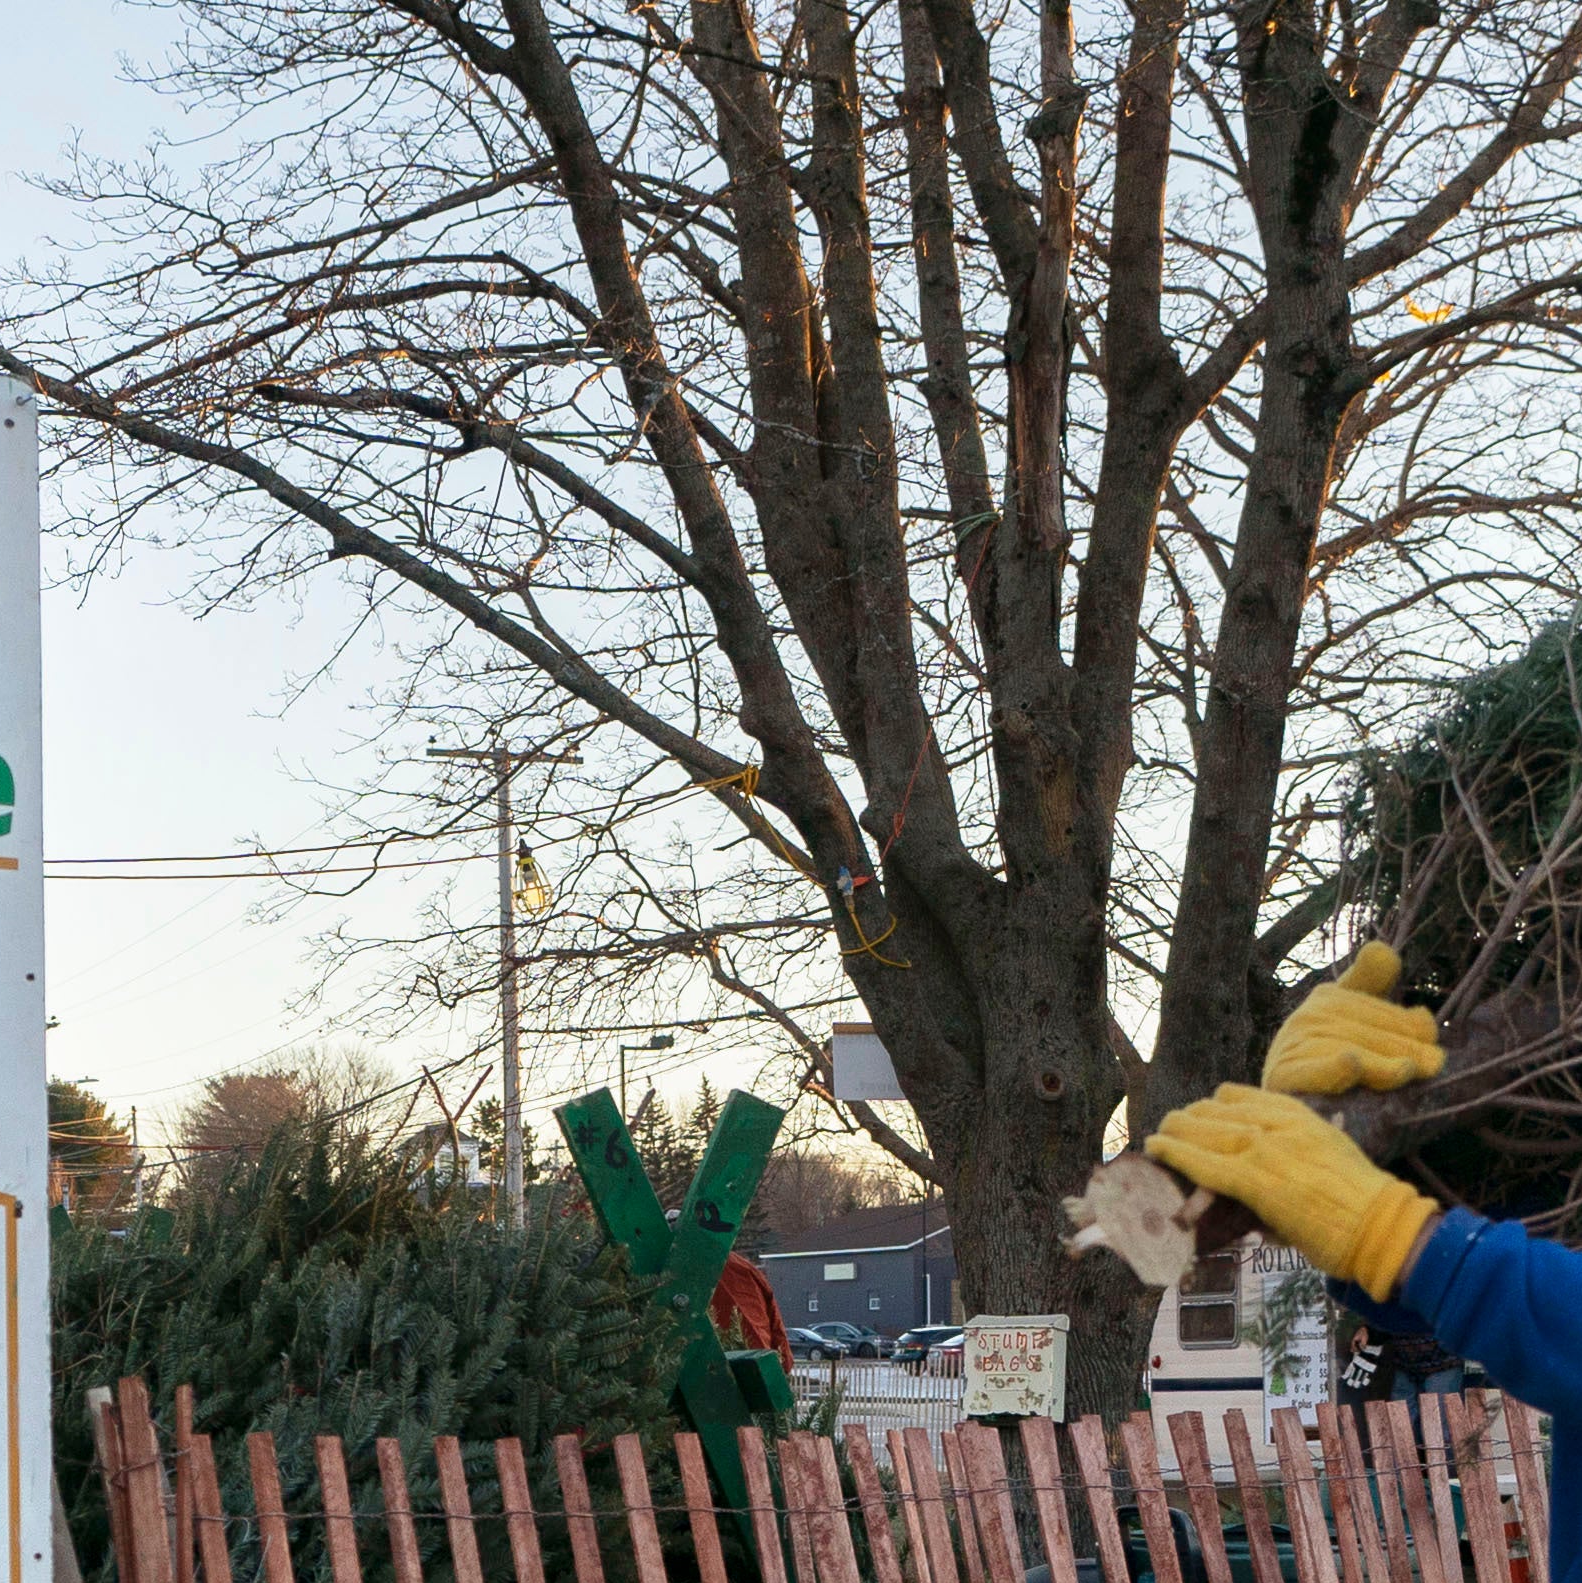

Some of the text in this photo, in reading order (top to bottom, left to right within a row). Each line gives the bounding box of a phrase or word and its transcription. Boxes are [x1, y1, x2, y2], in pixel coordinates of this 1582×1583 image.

[1252, 1247, 1307, 1273] ROTAR
[978, 1331, 1049, 1352] STUMP
[982, 1354, 1042, 1373] BAGS
